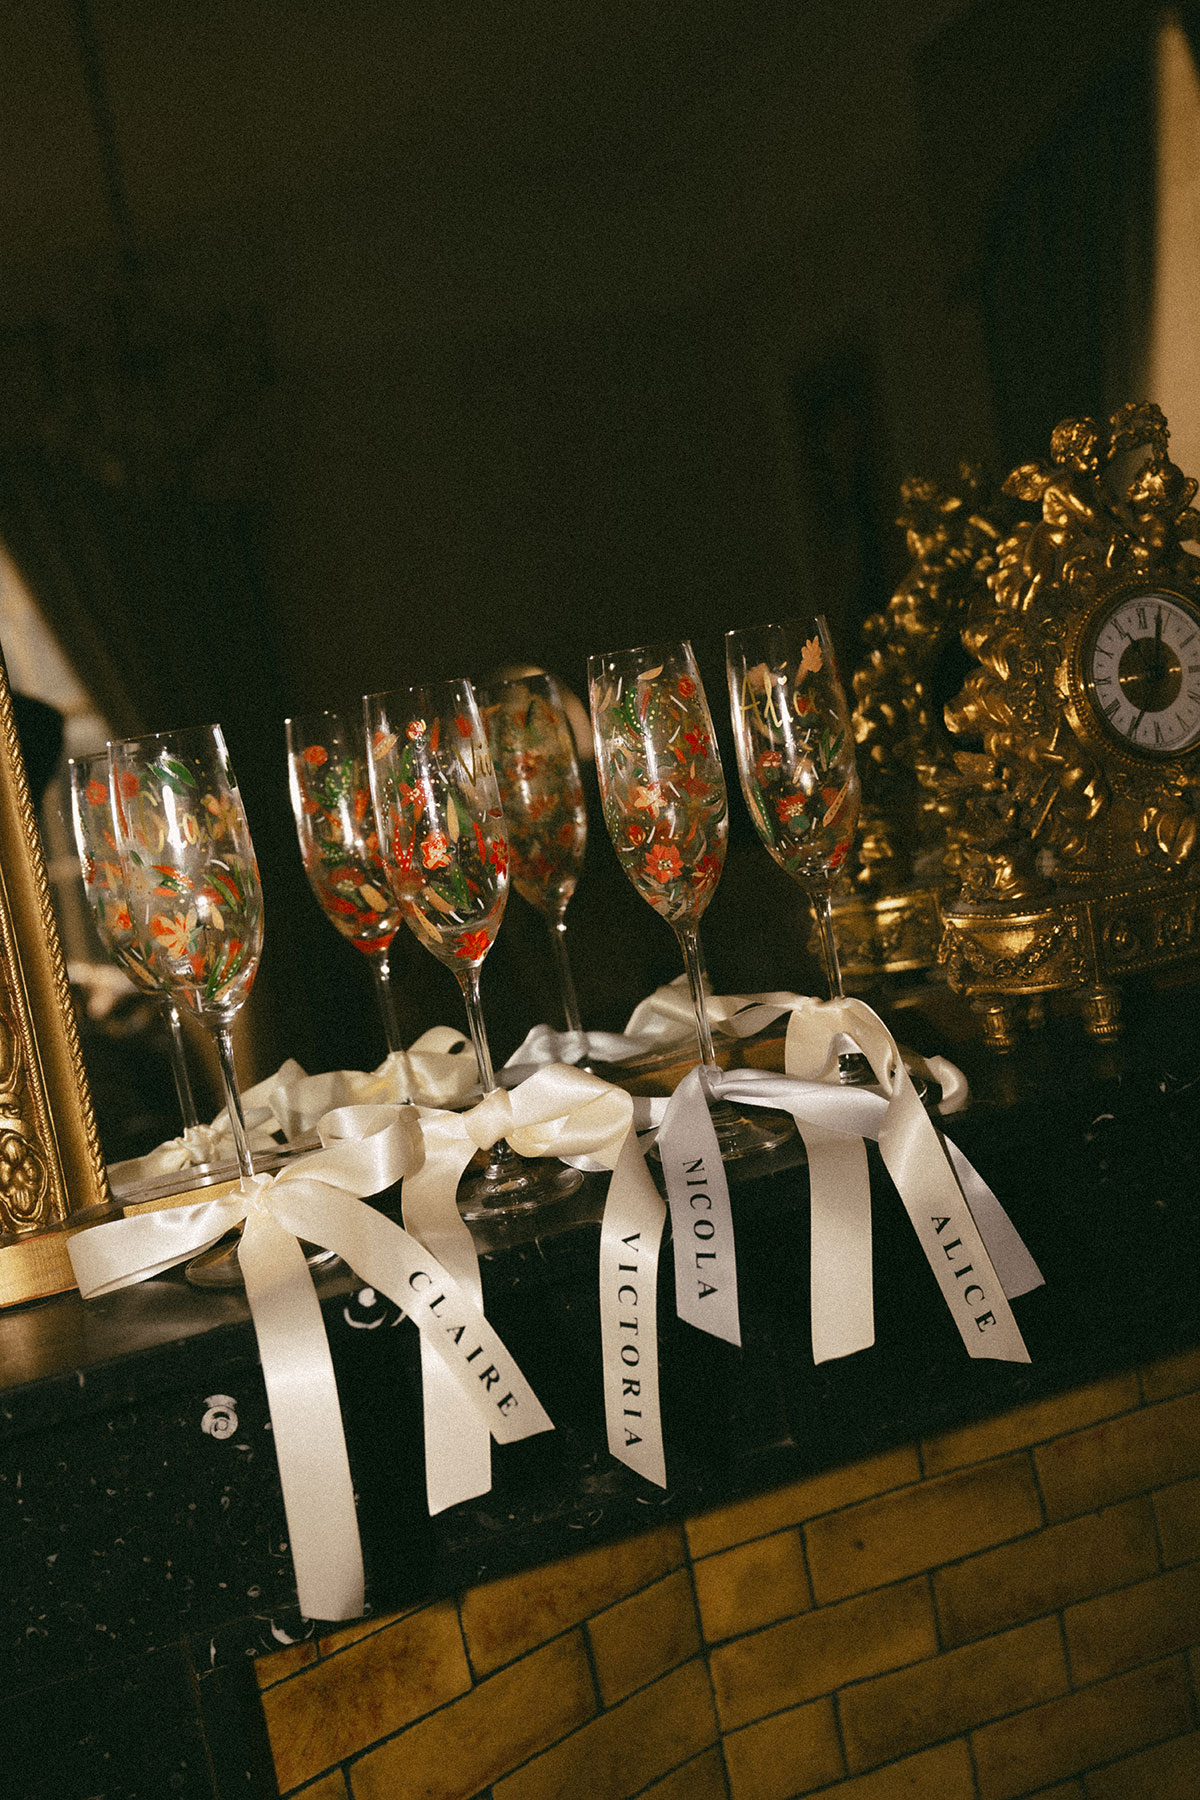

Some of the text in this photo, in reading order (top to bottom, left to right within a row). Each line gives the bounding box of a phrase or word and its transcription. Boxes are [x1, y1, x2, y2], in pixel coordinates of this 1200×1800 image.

[682, 1157, 719, 1300] NICOLA
[930, 1215, 997, 1333] ALICE
[408, 1271, 519, 1417] CLAIRE
[617, 1232, 643, 1446] VICTORIA
